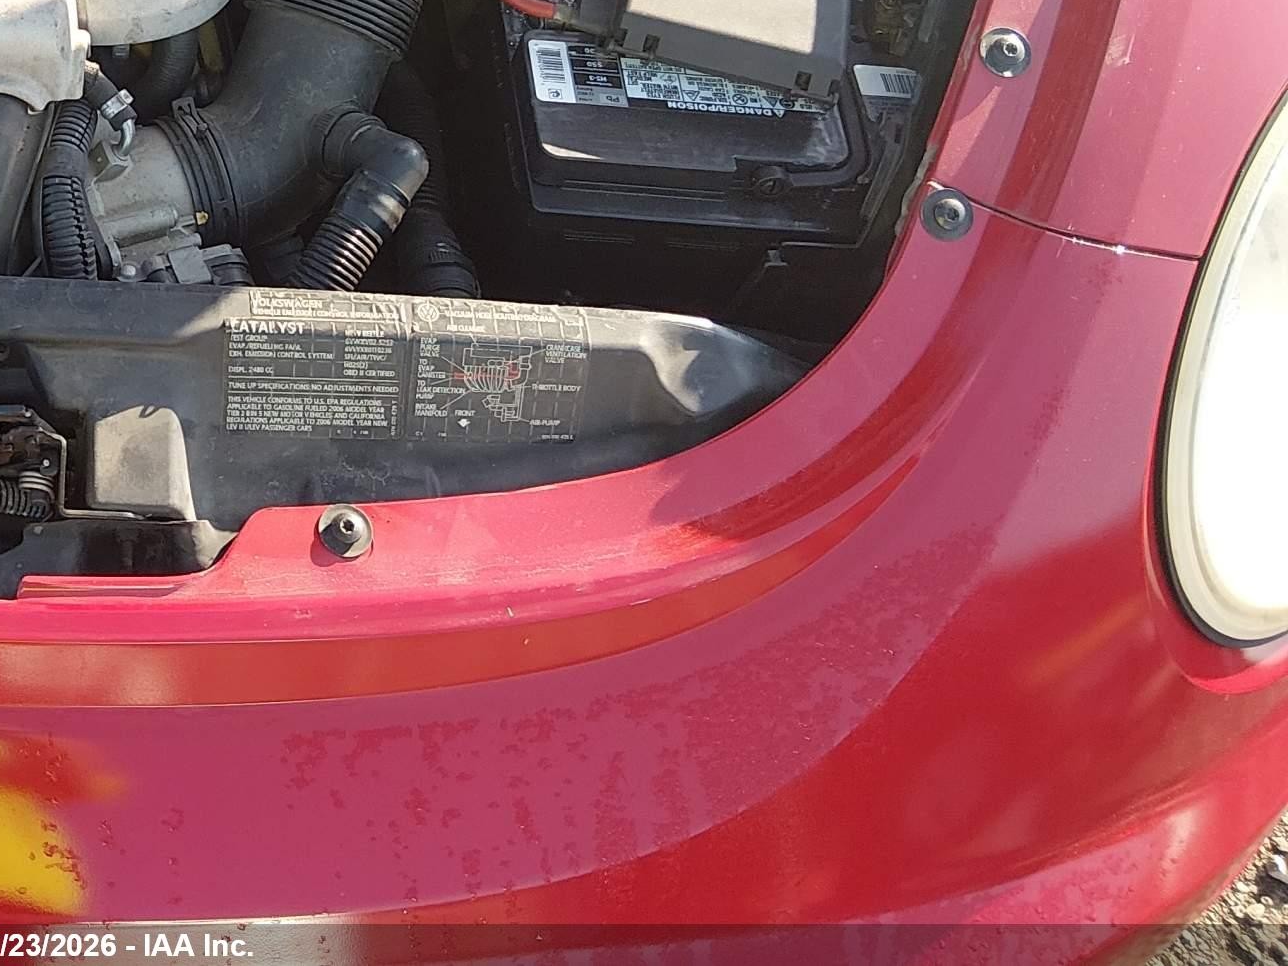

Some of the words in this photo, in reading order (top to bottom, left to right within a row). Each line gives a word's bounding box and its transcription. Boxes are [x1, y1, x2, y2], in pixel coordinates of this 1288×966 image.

[668, 100, 773, 116] DANGER/POISON
[252, 298, 322, 308] VOLKSWAGEN
[231, 319, 305, 334] CATALYST
[546, 344, 583, 352] CRANKCASE
[277, 351, 307, 359] CONTROL
[546, 351, 586, 359] VENTILATION
[532, 383, 562, 391] THROTTLE
